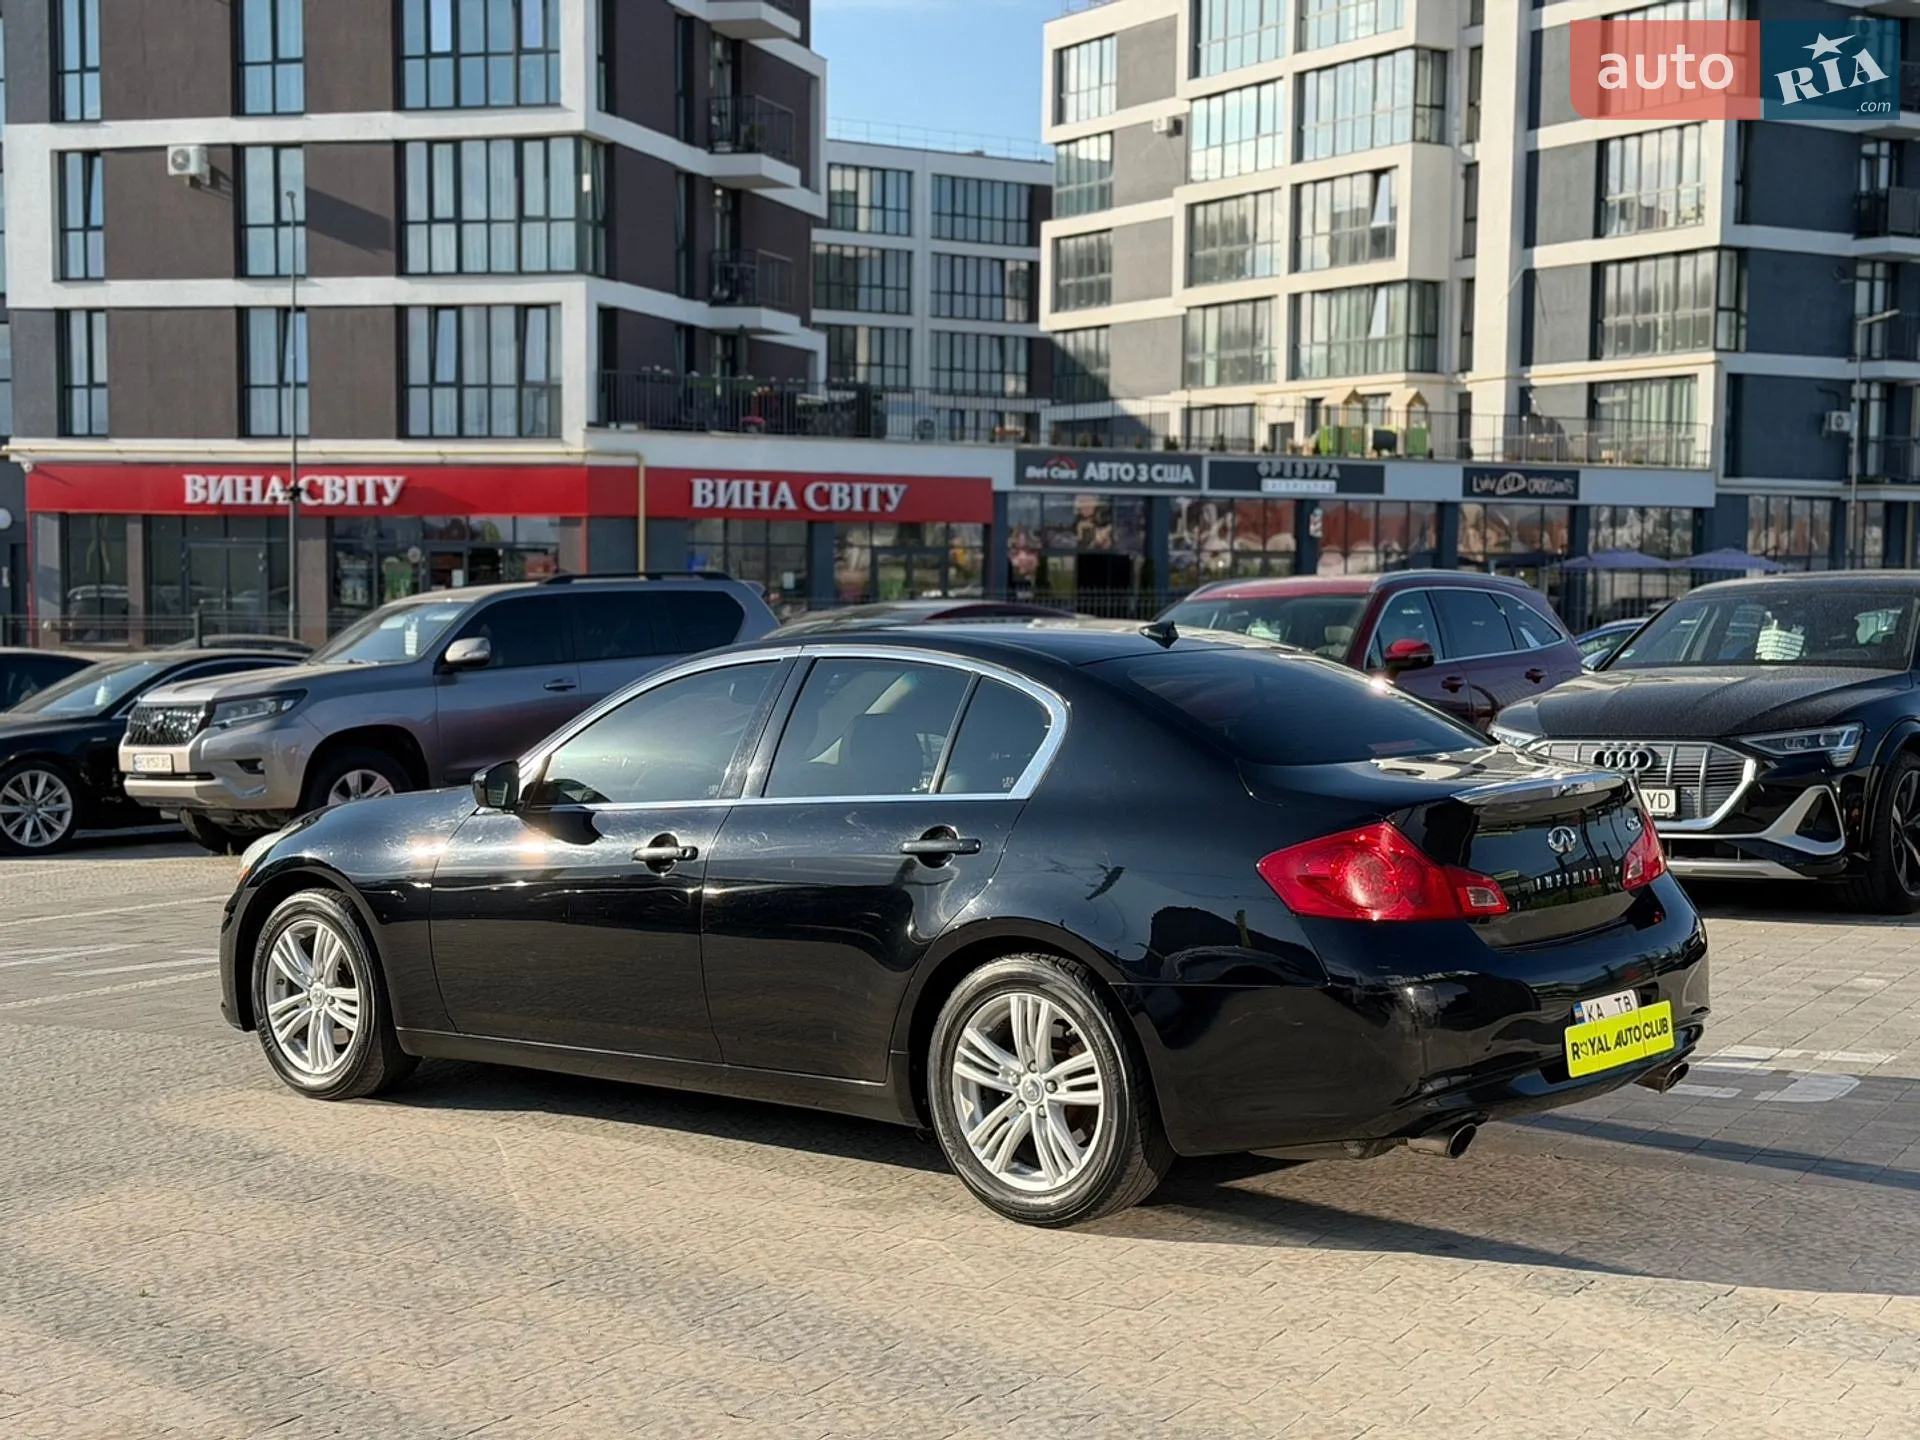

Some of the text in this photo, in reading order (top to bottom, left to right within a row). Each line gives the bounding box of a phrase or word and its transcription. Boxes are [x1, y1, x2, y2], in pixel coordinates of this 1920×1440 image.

[1083, 461, 1136, 482] АВТО
[1151, 464, 1195, 483] США
[183, 474, 406, 507] ВИНА СВІТУ
[689, 477, 909, 513] ВИНА СВІТУ
[1646, 791, 1671, 809] YD
[1535, 866, 1603, 891] INFINITI
[1613, 1024, 1642, 1050] AUTO
[1642, 1017, 1670, 1041] CLUB
